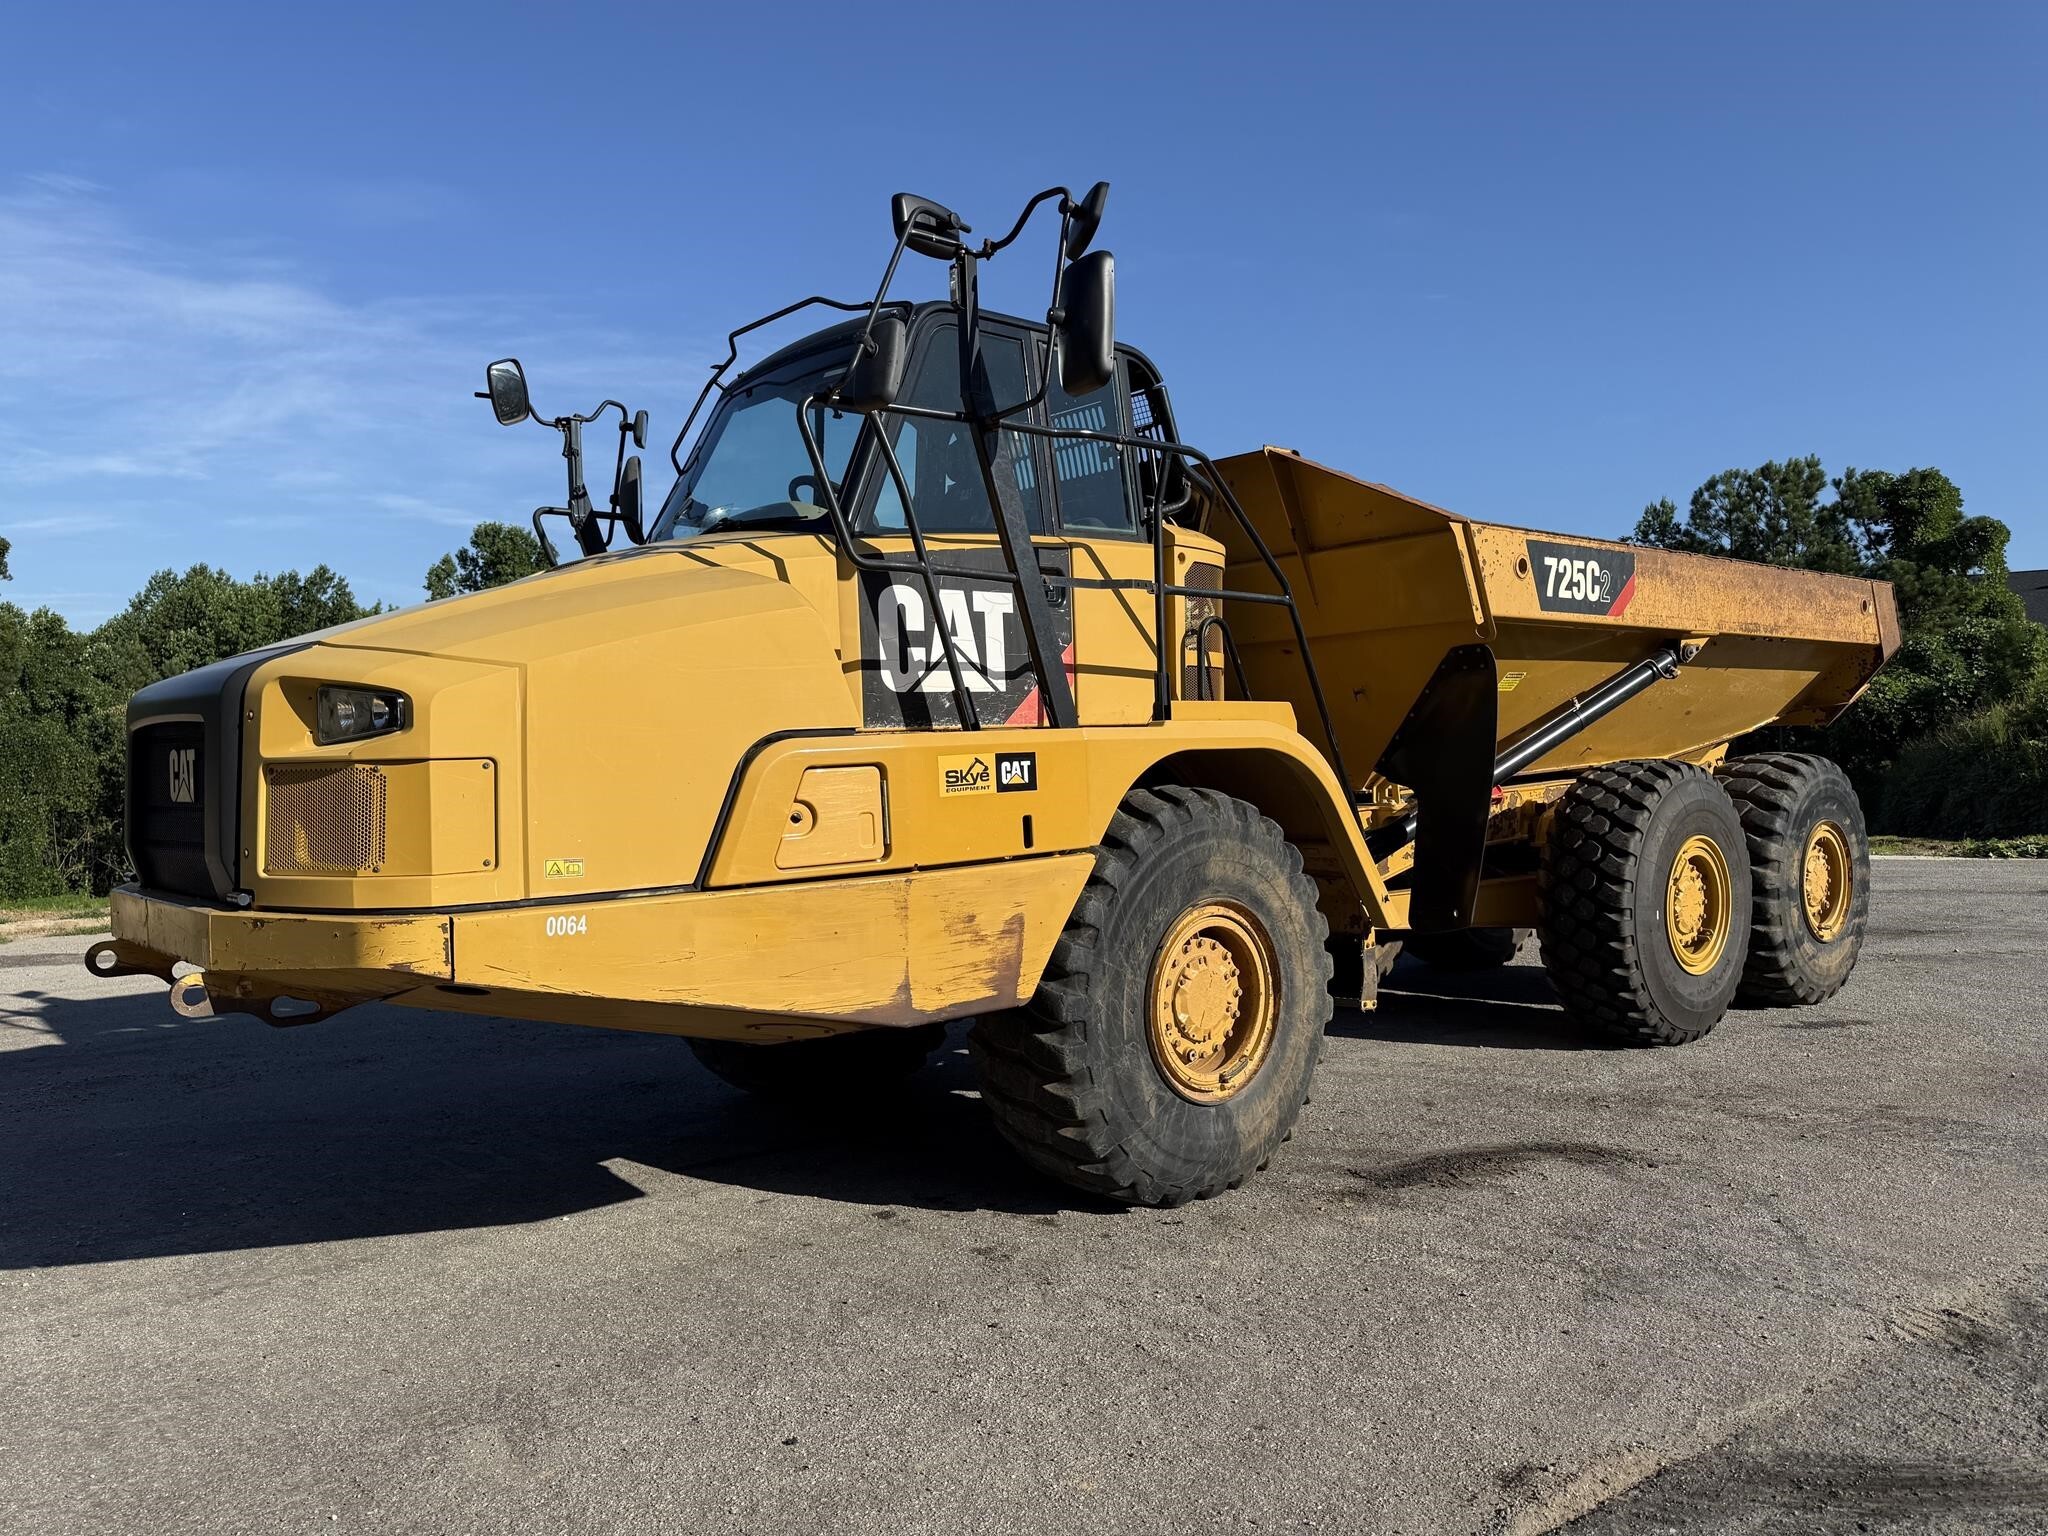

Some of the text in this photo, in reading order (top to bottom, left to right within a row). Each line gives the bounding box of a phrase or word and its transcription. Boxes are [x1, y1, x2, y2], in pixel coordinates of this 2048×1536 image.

[878, 584, 1014, 693] CAT
[169, 748, 196, 803] CAT
[1001, 760, 1031, 785] CAT
[946, 785, 991, 794] EQUIPMENT
[546, 914, 588, 937] 0064
